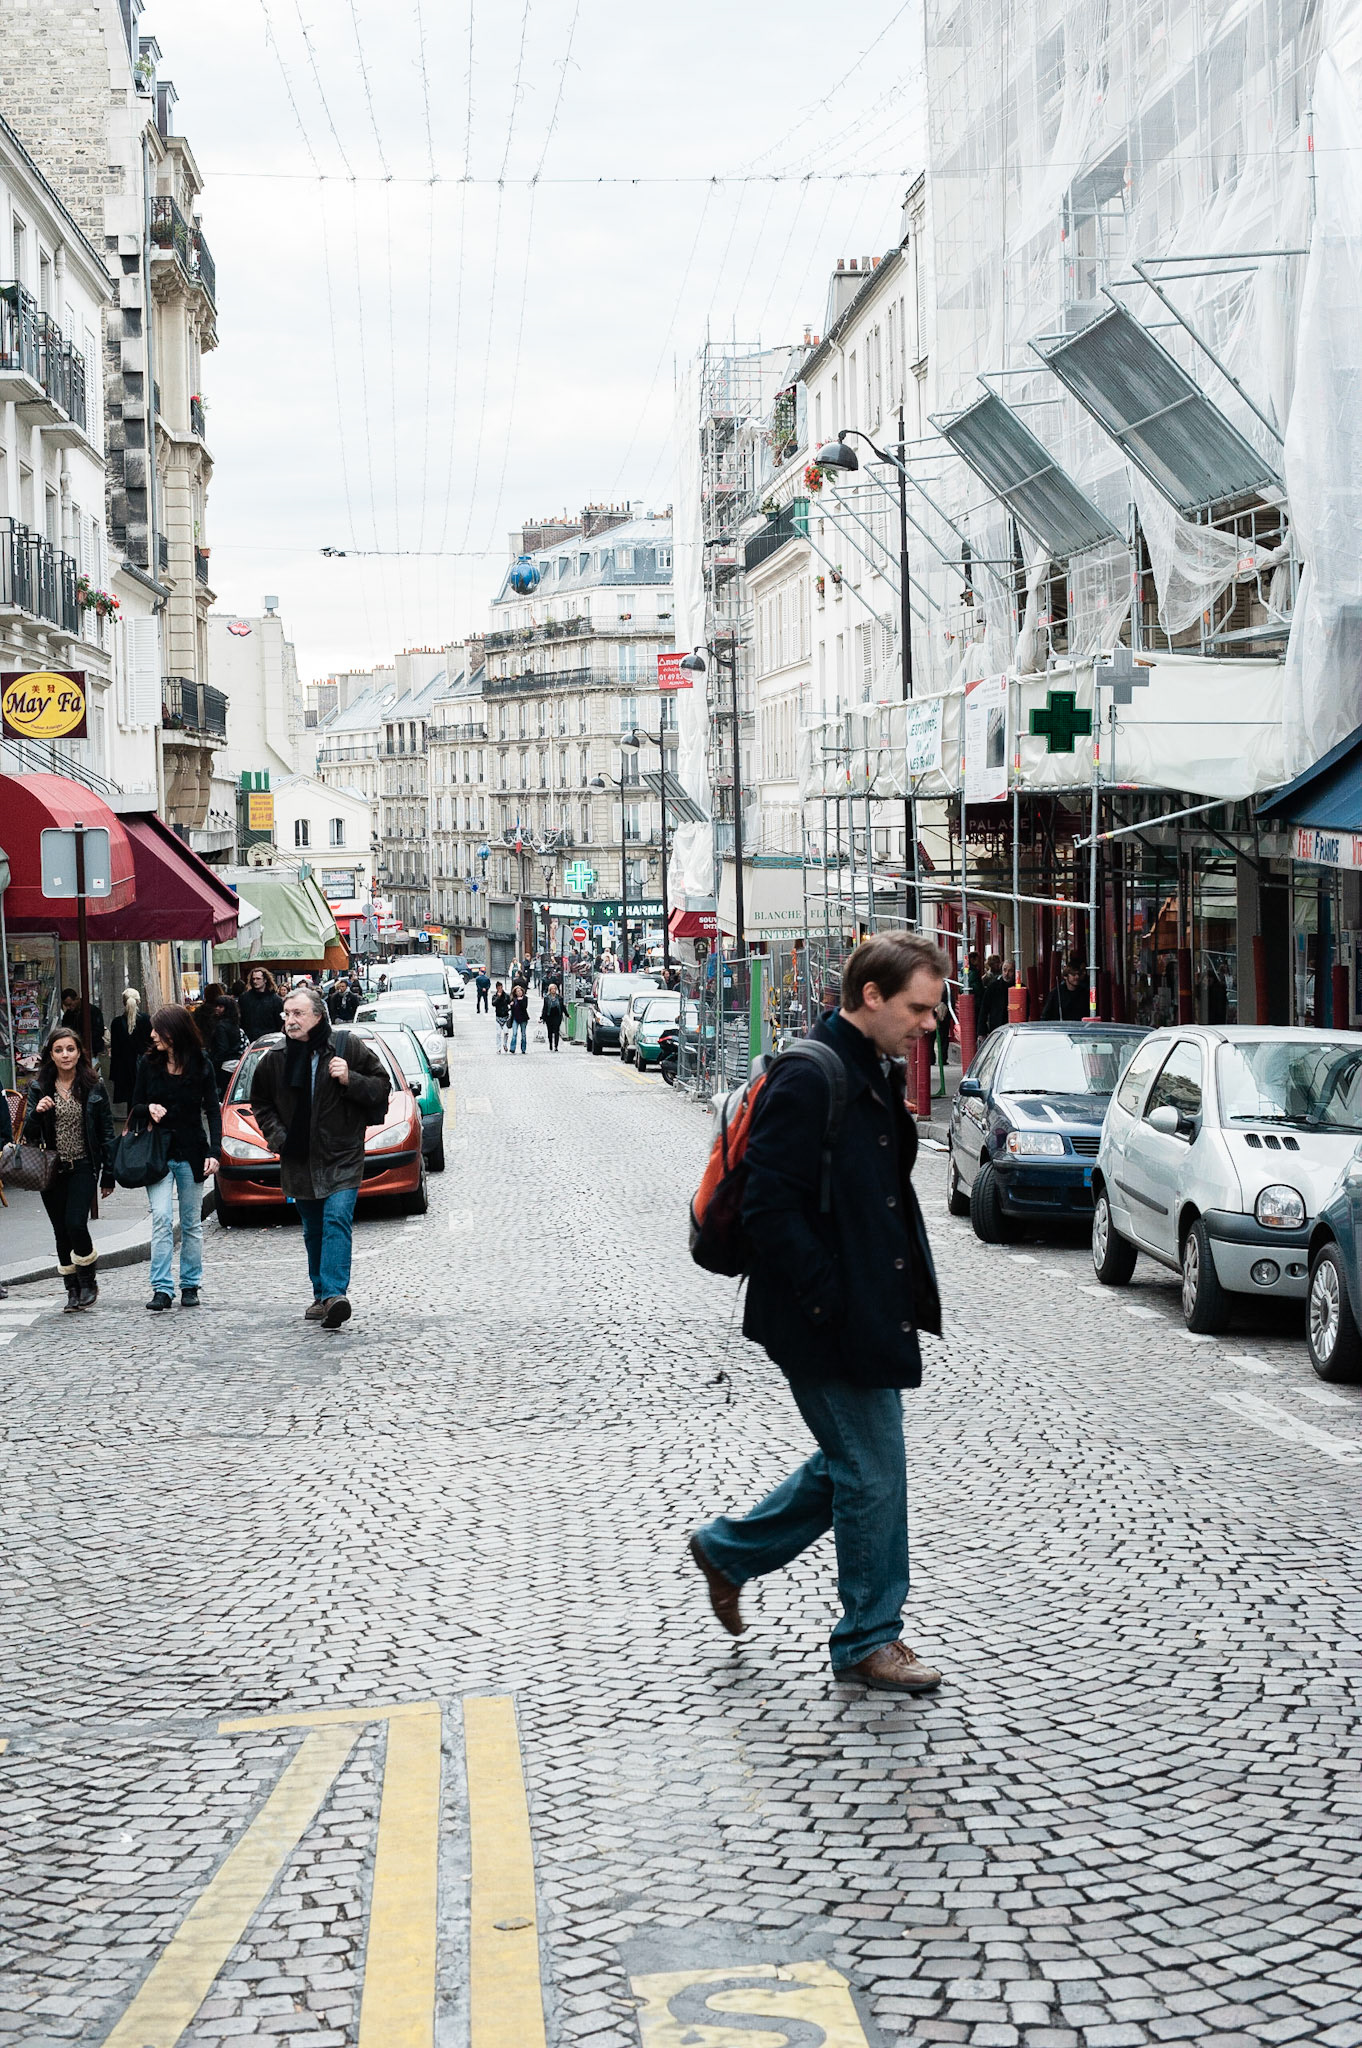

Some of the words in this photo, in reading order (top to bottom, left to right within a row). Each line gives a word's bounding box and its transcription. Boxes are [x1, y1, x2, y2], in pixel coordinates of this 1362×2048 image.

[6, 692, 52, 723] May
[58, 692, 81, 712] Fa
[1297, 829, 1312, 858] TÉLÉ
[1314, 831, 1339, 863] FRANCE
[754, 910, 802, 920] BLANCHE
